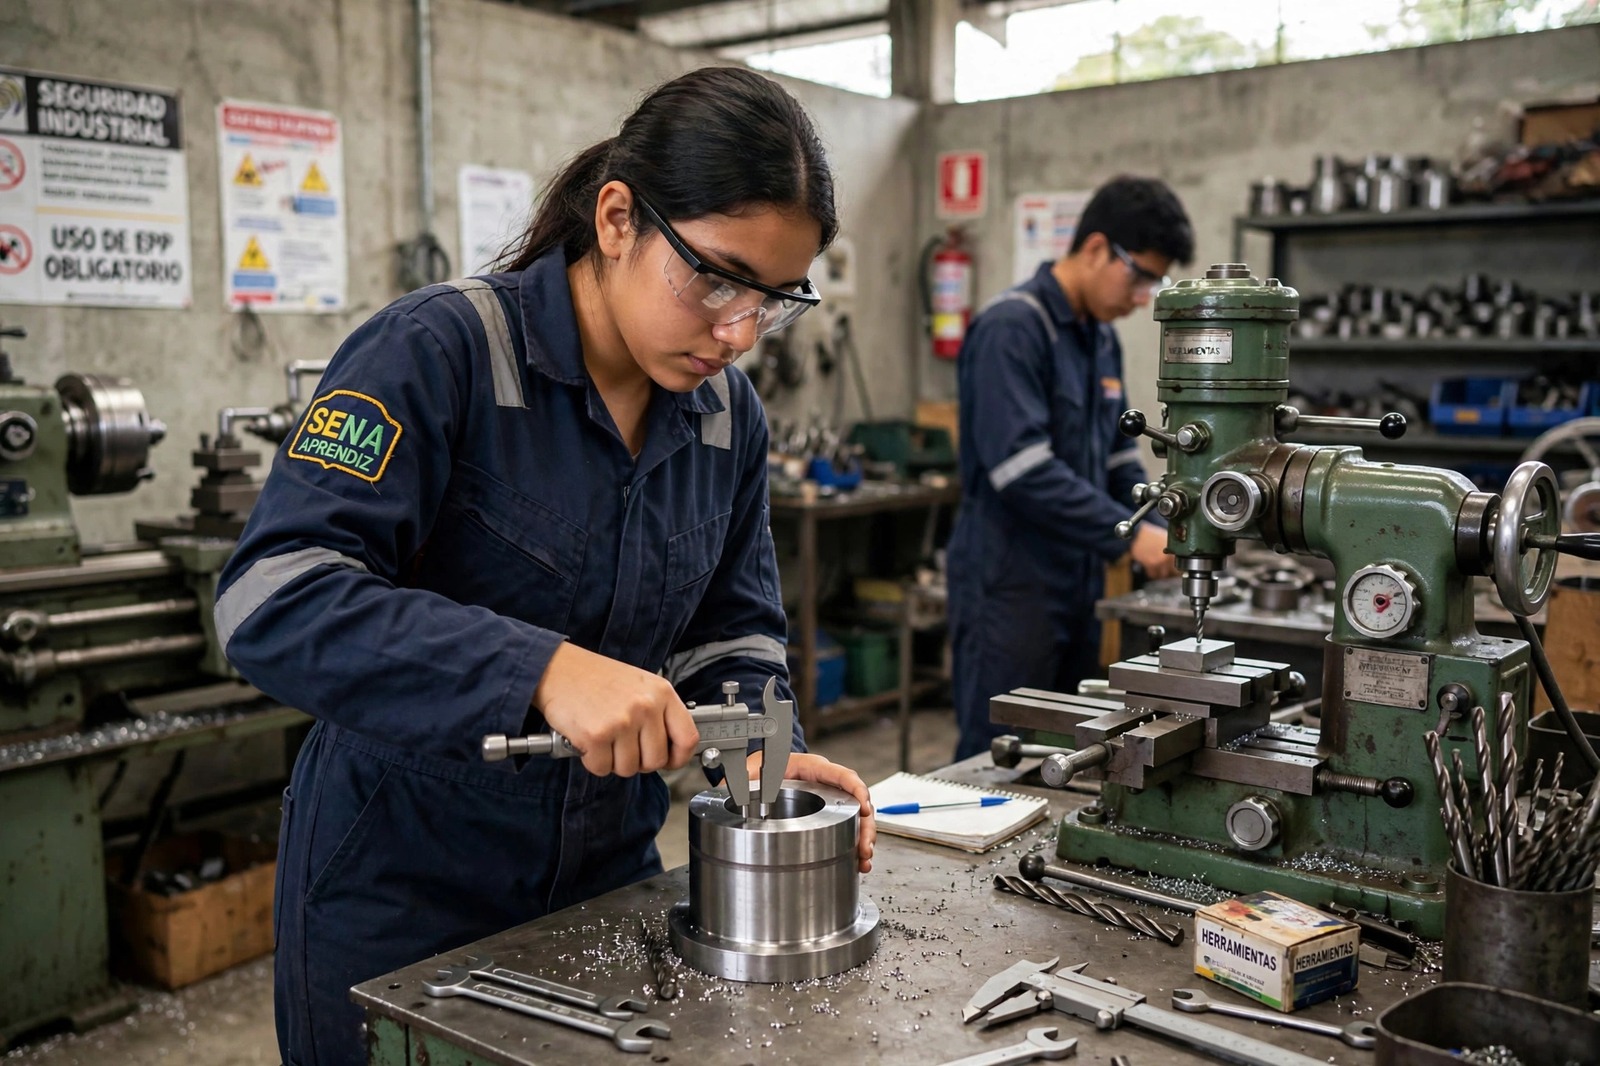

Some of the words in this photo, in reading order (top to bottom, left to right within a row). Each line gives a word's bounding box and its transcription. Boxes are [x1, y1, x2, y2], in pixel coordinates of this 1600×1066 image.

[37, 79, 167, 121] SEGURIDAD
[37, 107, 170, 147] INDUSTRIAL
[51, 226, 97, 251] USO
[101, 227, 128, 254] DE
[135, 230, 174, 255] EPP
[44, 254, 183, 284] OBLIGATORIO
[307, 406, 385, 456] SENA
[297, 436, 375, 472] APRENDIZ
[1201, 927, 1277, 972] HERRAMIENTAS
[1295, 941, 1354, 971] HERRAMIENTAS
